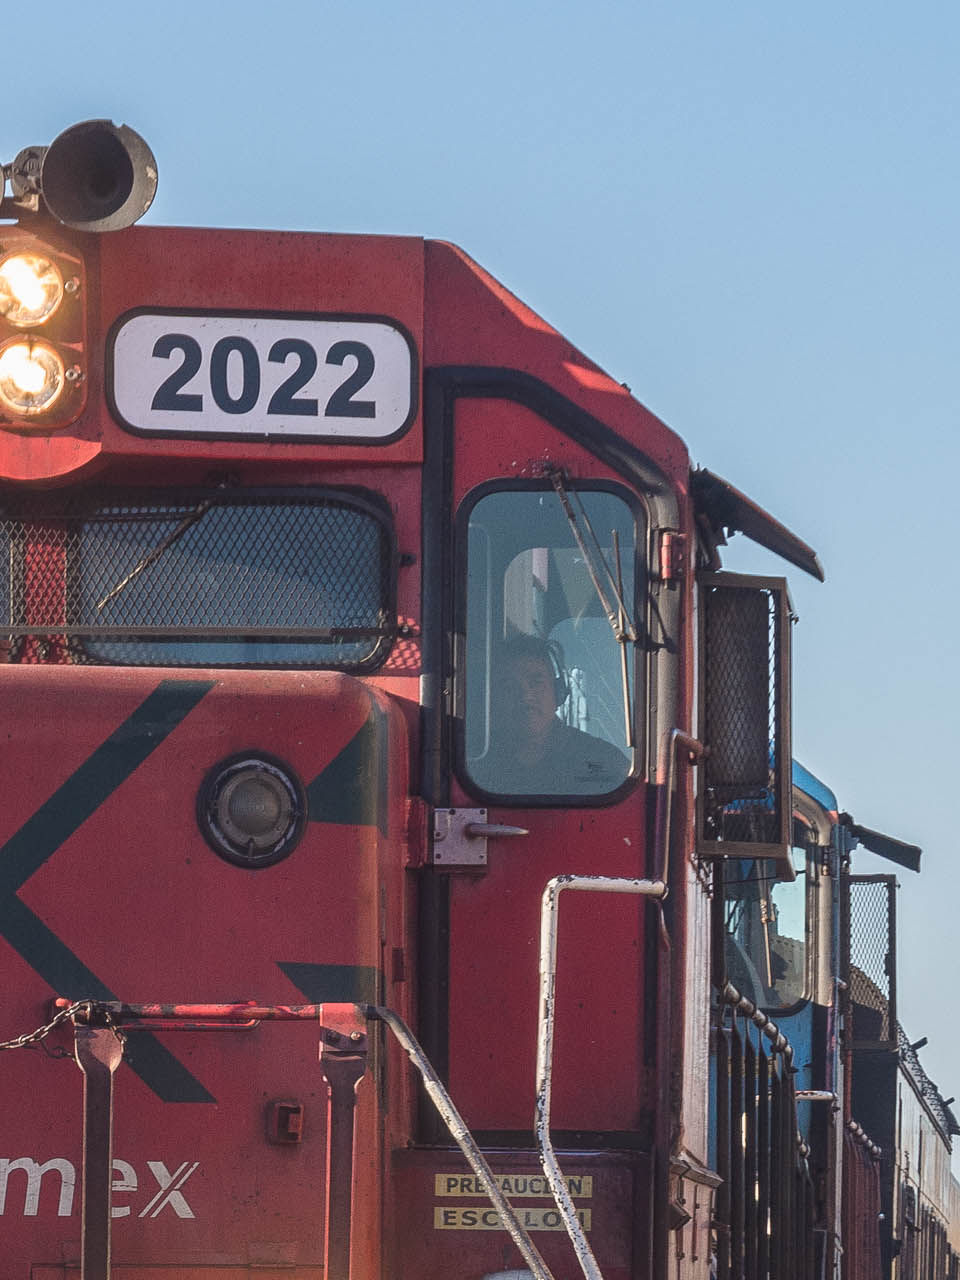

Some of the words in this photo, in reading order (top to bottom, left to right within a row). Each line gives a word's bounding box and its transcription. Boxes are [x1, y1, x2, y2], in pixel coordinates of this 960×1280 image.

[149, 333, 377, 419] 2022
[446, 1177, 583, 1194] PREAUCIN
[443, 1210, 586, 1228] ESCLO
